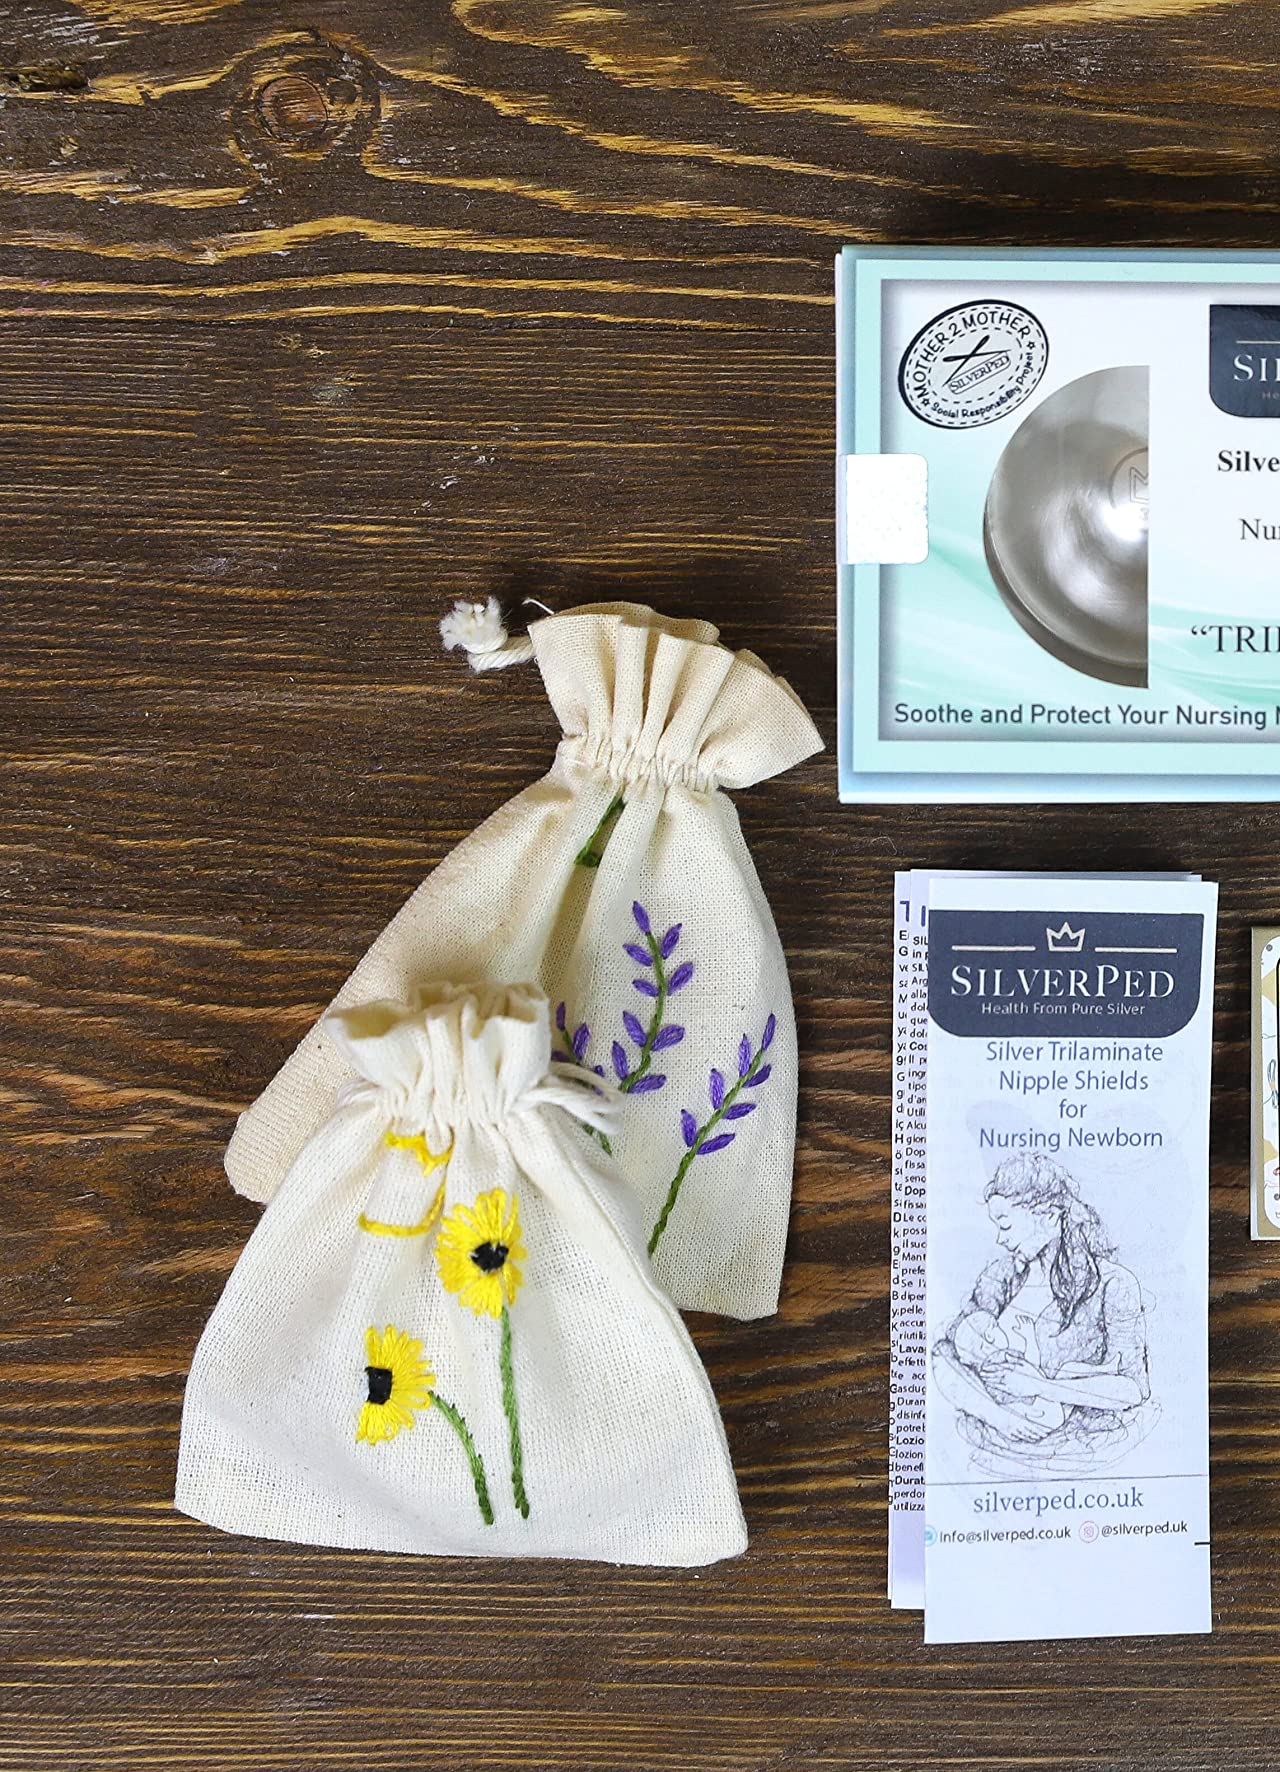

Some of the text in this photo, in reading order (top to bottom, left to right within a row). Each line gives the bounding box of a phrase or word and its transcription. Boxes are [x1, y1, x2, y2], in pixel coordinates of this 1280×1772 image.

[913, 310, 1031, 399] MOTHER 2 MOTHER
[894, 703, 973, 724] Soothe
[980, 704, 1023, 724] and
[1031, 704, 1111, 724] Protect
[1118, 705, 1168, 725] Your
[1176, 705, 1266, 729] Nursing
[951, 964, 1175, 999] SILVERPED
[981, 1003, 1145, 1016] Health From Pure Silver
[986, 1041, 1164, 1062] Silver Trilaminate
[999, 1070, 1148, 1094] Nipple Shields
[1059, 1099, 1087, 1118] for
[979, 1127, 1163, 1153] Nursing Newborn
[973, 1487, 1144, 1516] silverped.co.uk
[939, 1526, 1071, 1543] info@silverped.co.uk
[1101, 1520, 1188, 1539] @silverped.uk
